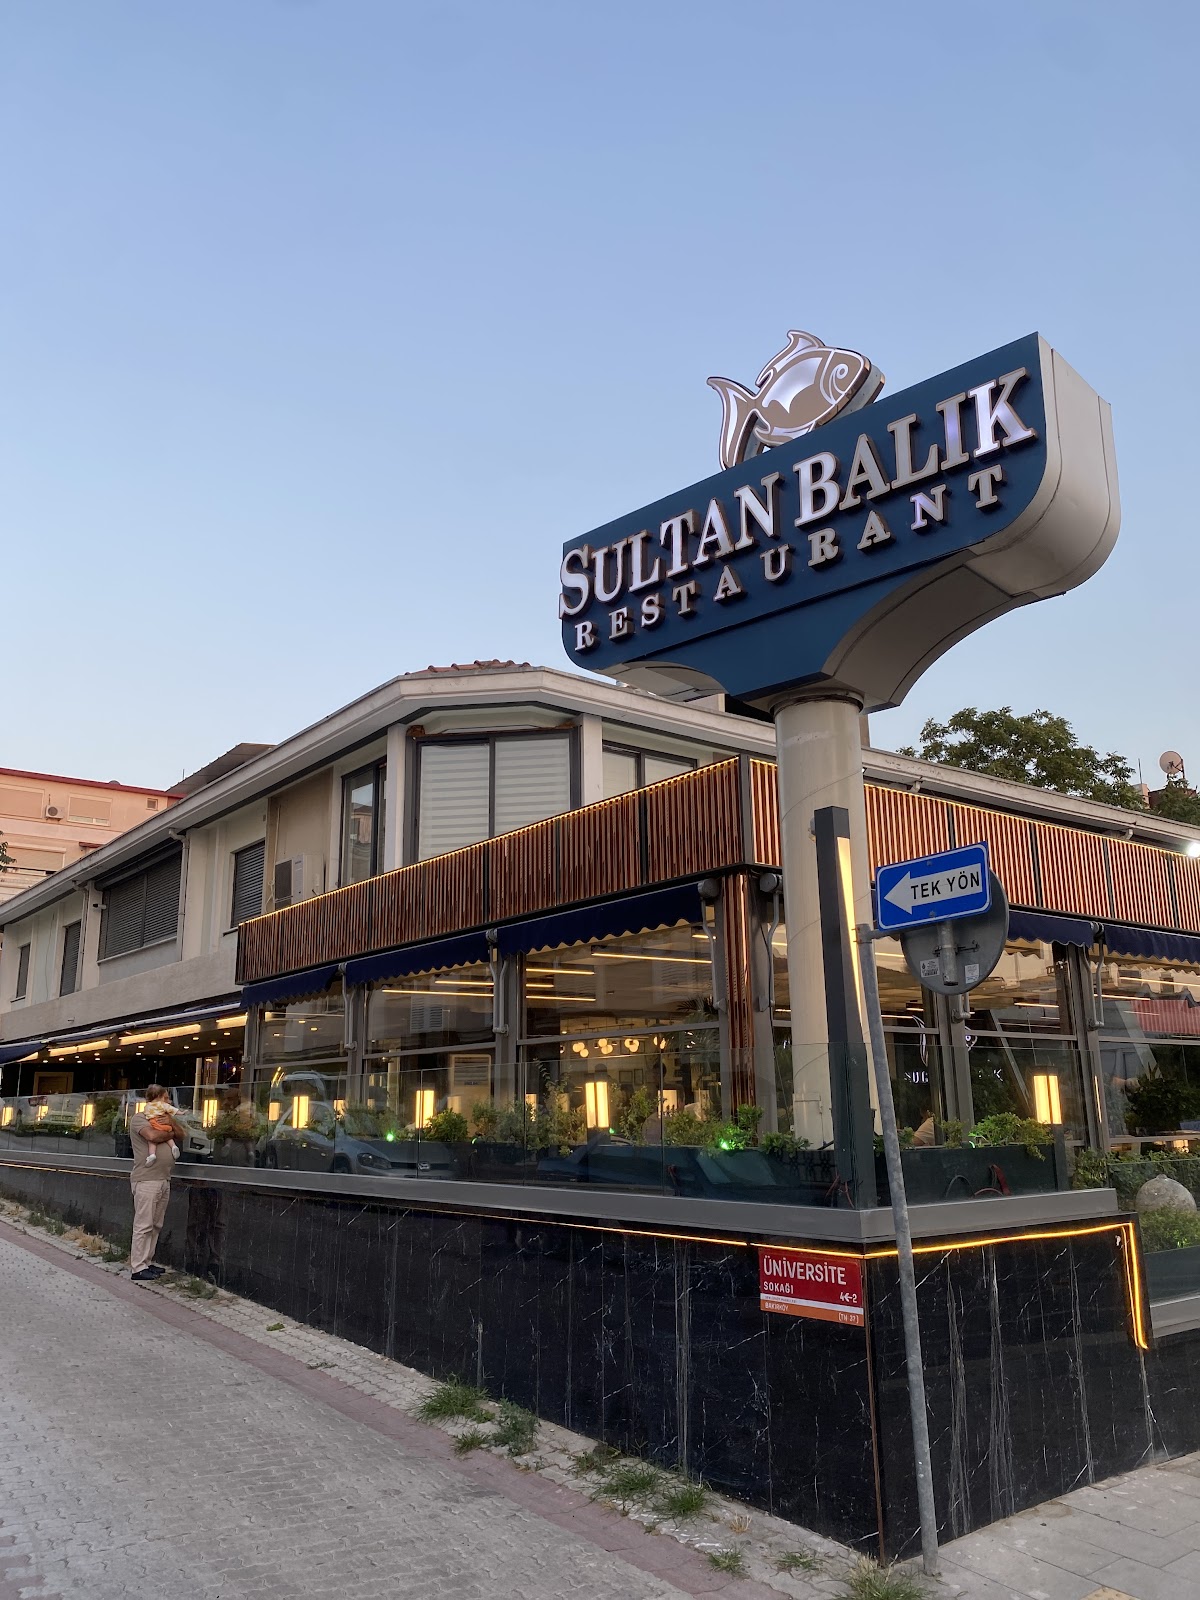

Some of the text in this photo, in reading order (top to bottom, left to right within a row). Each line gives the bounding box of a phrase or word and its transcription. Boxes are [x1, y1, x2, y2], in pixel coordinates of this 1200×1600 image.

[559, 366, 1038, 619] SULTAN BALIK
[574, 464, 1006, 652] RESTAURANT
[911, 871, 980, 900] TEK YÖN
[763, 1255, 847, 1285] ÜNİVERSİTE
[763, 1281, 794, 1294] SOKAĞI
